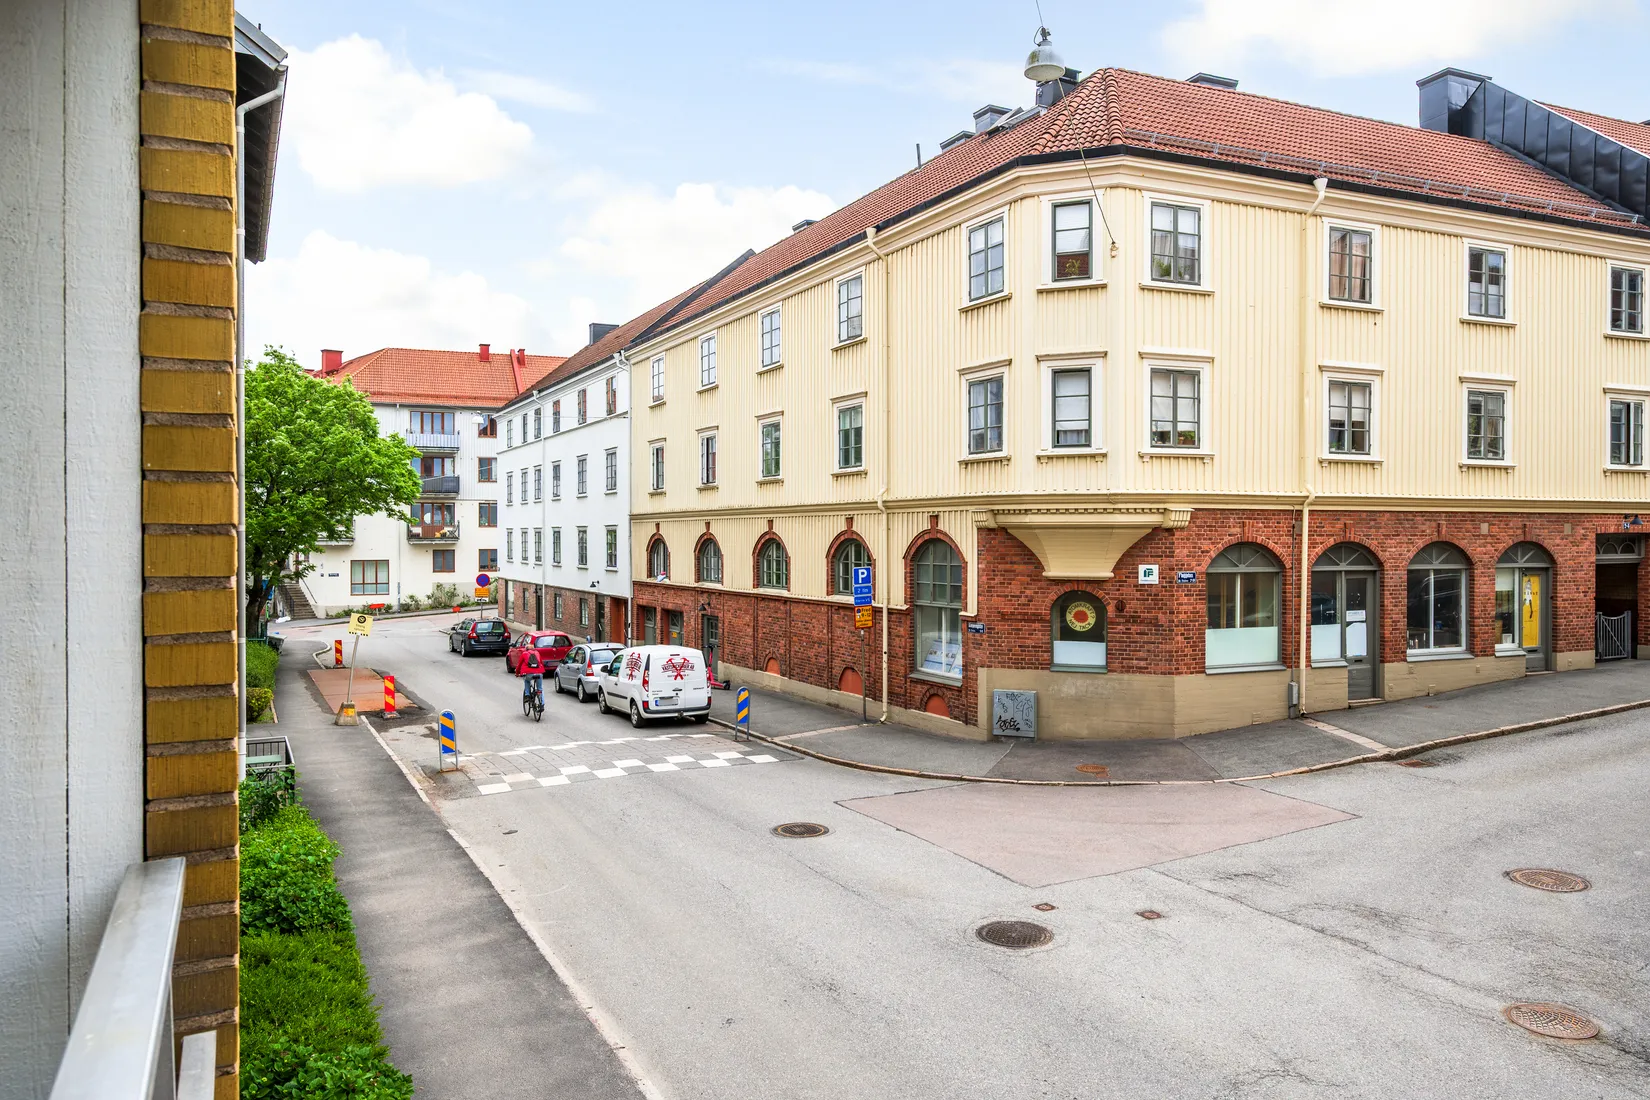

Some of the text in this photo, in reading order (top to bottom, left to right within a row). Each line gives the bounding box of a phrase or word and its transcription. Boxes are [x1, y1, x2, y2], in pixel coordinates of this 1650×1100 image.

[858, 569, 867, 584] P
[1068, 619, 1092, 630] NEJ TACK
